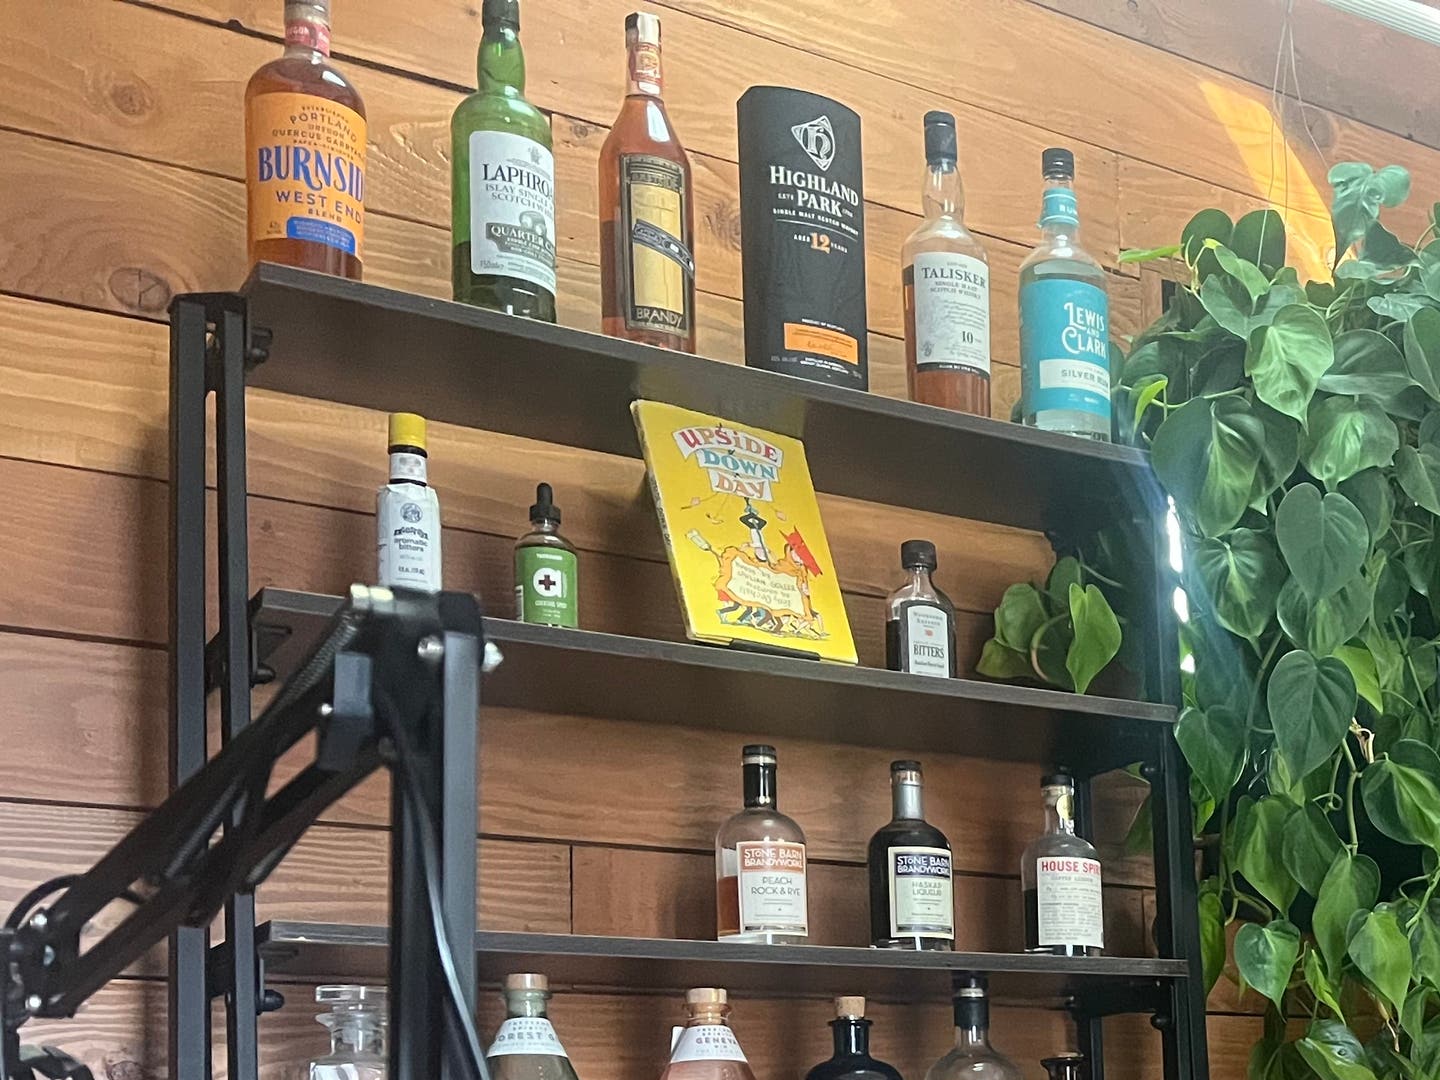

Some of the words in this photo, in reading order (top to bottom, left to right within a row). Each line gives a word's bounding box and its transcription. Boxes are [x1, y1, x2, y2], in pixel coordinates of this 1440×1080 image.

[290, 112, 357, 142] PORTLAND
[769, 165, 859, 206] HIGHLAND
[276, 190, 327, 208] WEST
[335, 201, 361, 224] END
[797, 189, 843, 218] PARK
[490, 225, 544, 247] QUARTER
[810, 232, 831, 254] 12
[922, 267, 986, 288] TALISKER
[636, 307, 683, 328] BRANDY
[1064, 302, 1105, 332] LEWIS
[962, 331, 974, 344] 10
[1062, 326, 1106, 359] CLARK
[1061, 369, 1095, 381] SILVER
[703, 449, 775, 480] DOWN
[715, 473, 764, 498] DAY
[913, 644, 945, 659] BITTERS
[779, 849, 802, 860] BARN
[1041, 861, 1079, 872] HOUSE
[751, 886, 778, 895] ROCK
[788, 888, 801, 896] RYE
[762, 876, 793, 885] PEACH
